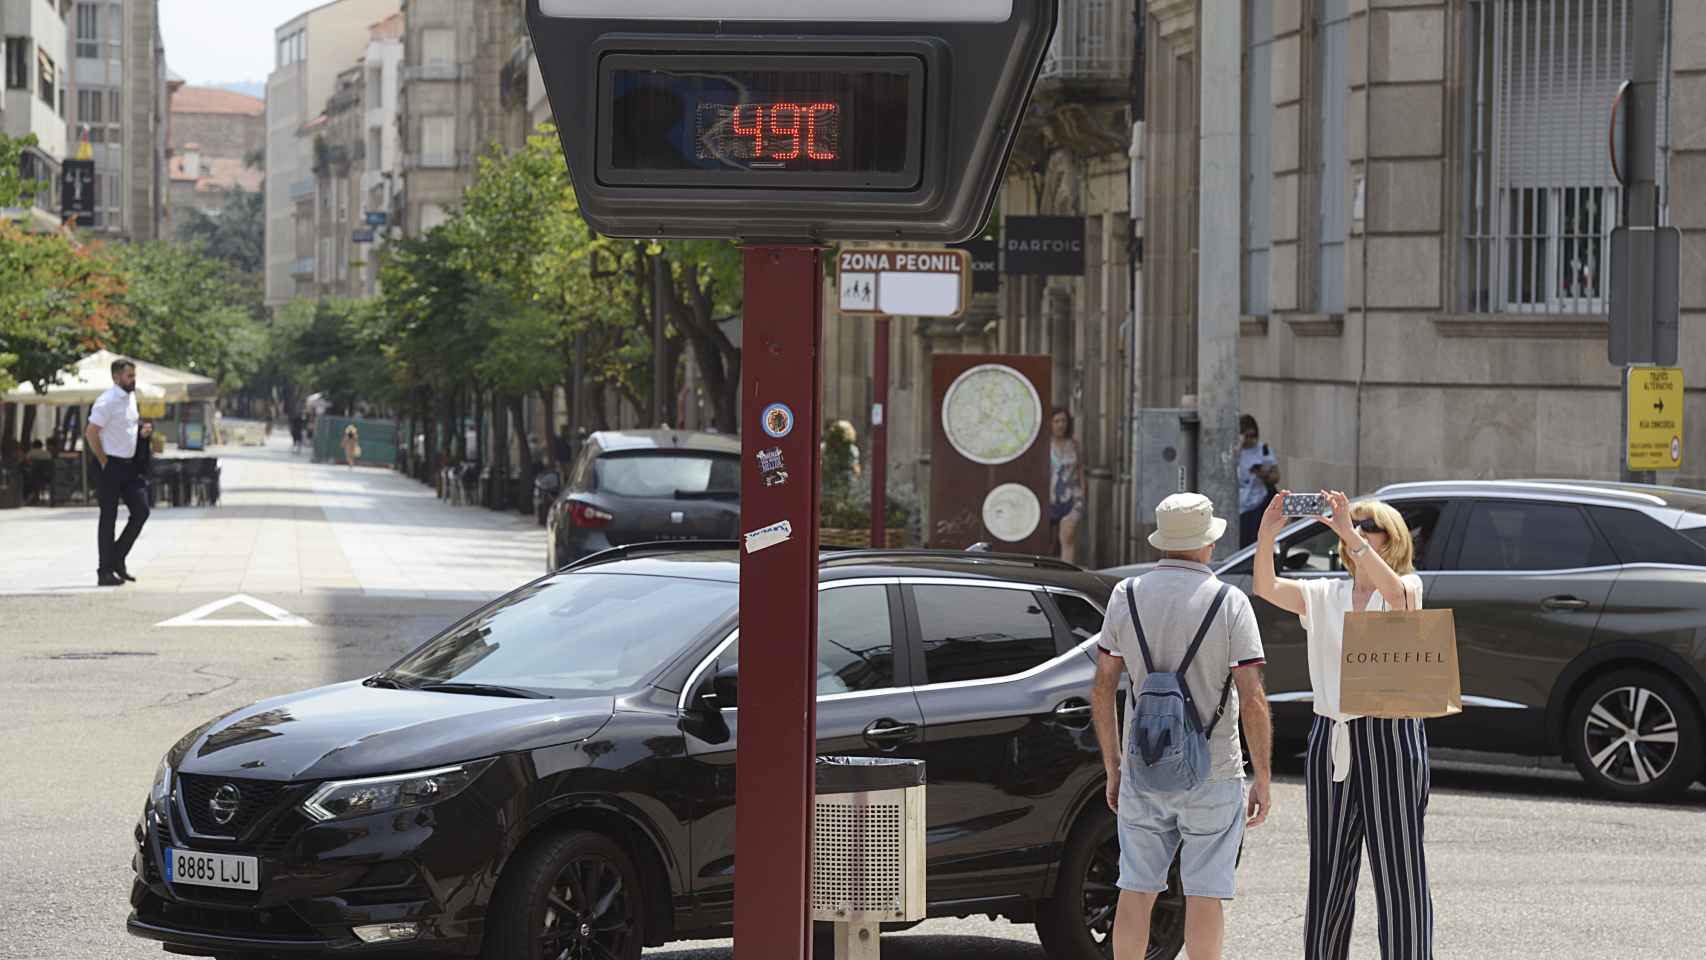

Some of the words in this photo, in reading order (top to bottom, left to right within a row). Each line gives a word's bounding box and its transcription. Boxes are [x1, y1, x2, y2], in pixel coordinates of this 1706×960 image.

[841, 253, 890, 270] ZONA
[895, 254, 960, 270] PEONIL
[1346, 652, 1446, 664] CORTEFIEL
[178, 855, 215, 880] 8885
[220, 859, 251, 885] LJL
